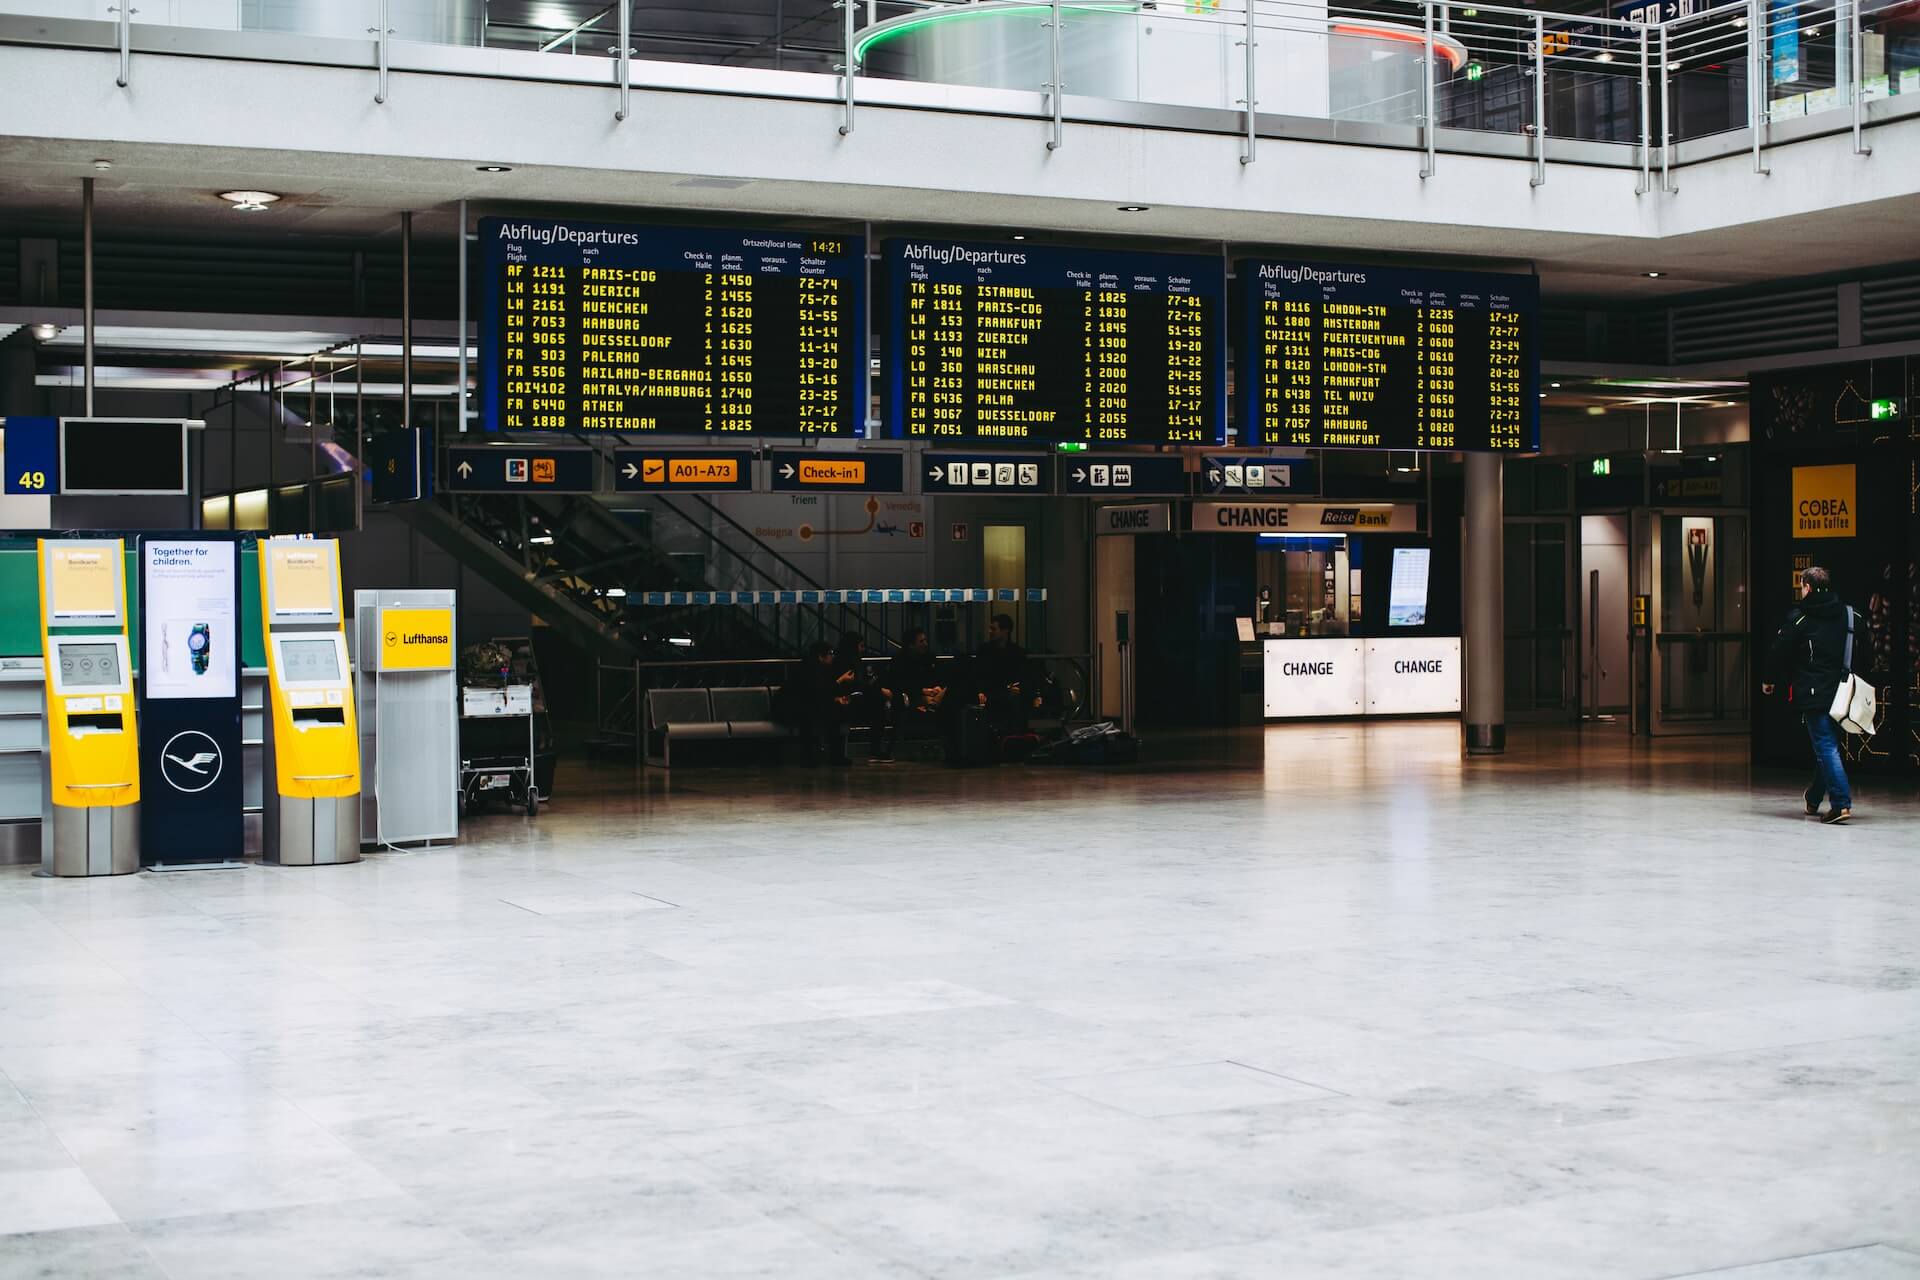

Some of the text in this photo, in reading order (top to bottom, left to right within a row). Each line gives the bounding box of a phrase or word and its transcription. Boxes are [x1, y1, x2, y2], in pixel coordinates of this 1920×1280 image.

[499, 224, 639, 246] Abflug/Departures
[743, 239, 802, 249] Ortszeit/local time
[506, 244, 523, 253] Flug
[684, 251, 705, 260] Check
[813, 241, 842, 254] 14:21
[904, 244, 1027, 265] Abflug/Departures
[506, 253, 528, 262] Flight
[695, 261, 713, 269] Halle
[799, 257, 827, 266] Schalter
[721, 263, 743, 271] sched.
[761, 265, 781, 273] estim.
[799, 266, 826, 275] Counter
[1259, 264, 1367, 284] Abflug/Departures
[532, 265, 838, 290] 1211 PARIS-CDG 1450 72-74
[532, 282, 838, 306] 1191 ZUERICH 1455 75-76
[933, 283, 1202, 307] 1506 ISTANBUL 1825 77-81
[532, 299, 838, 322] 2161 MUENCHEN 1620 51-55
[933, 299, 1202, 322] 1811 PARIS-CDG 1830 72-76
[1284, 301, 1311, 313] 8116
[1429, 308, 1454, 320] 2235
[1489, 312, 1519, 323] 17-17
[532, 315, 838, 338] 7053 HAMBURG 1625 11-14
[940, 314, 1202, 337] 153 FRANKFURT 1845 51-55
[1284, 315, 1519, 337] 1880 AMSTERDAM 0600 72-77
[532, 332, 838, 354] 9065 DUESSELDORF 1630 11-14
[933, 330, 1202, 352] 1193 ZUERICH 1900 19-20
[1323, 332, 1454, 348] FUERTEVENTURA 0600
[540, 349, 838, 370] 903 PALERMO 1645 19-20
[940, 346, 1202, 367] 140 WIEN 1920 21-22
[1284, 345, 1454, 362] 1311 PARIS-CDG 0610
[532, 365, 838, 385] 5506 MAILAND-BERGAMO 1650 16-16
[940, 361, 1202, 382] 360 WARSCHAU 2000 24-25
[1284, 359, 1311, 371] 8120
[1429, 365, 1454, 377] 0630
[933, 376, 1202, 396] 2163 MUENCHEN 2020 51-55
[1291, 374, 1455, 391] 143 FRANKFURT 0630
[582, 383, 705, 398] ANTALYA/HAMBURG
[720, 387, 752, 399] 1740
[799, 389, 838, 401] 23-25
[1284, 388, 1455, 405] 6438 TEL AVIV 0650
[532, 398, 838, 417] 6440 ATHEN 1810 17-17
[933, 392, 1202, 411] 6436 PALMA 2040 17-17
[933, 408, 1202, 426] 9067 DUESSELDORF 2055 11-14
[1291, 403, 1455, 419] 136 WIEN 0810
[532, 415, 838, 433] 1888 1825 72-76
[933, 423, 1202, 441] 7051 HAMBURG 2055 11-14
[1284, 417, 1455, 433] 7057 HAMBURG 0820
[1291, 432, 1455, 447] 145 FRANKFURT 0835
[18, 471, 46, 489] 49
[674, 465, 731, 478] A01-A73
[791, 495, 818, 505] Trient
[1799, 499, 1848, 516] COBEA
[1110, 509, 1149, 528] CHANGE
[1217, 508, 1289, 527] CHANGE
[1324, 511, 1388, 525] Reise Bank
[1799, 517, 1849, 530] Urban Coffee
[755, 527, 793, 539] Bologna
[152, 547, 209, 558] Together for
[152, 557, 193, 566] children.
[403, 633, 449, 645] Lufthansa
[1283, 662, 1335, 677] CHANGE
[1394, 660, 1443, 674] CHANGE
